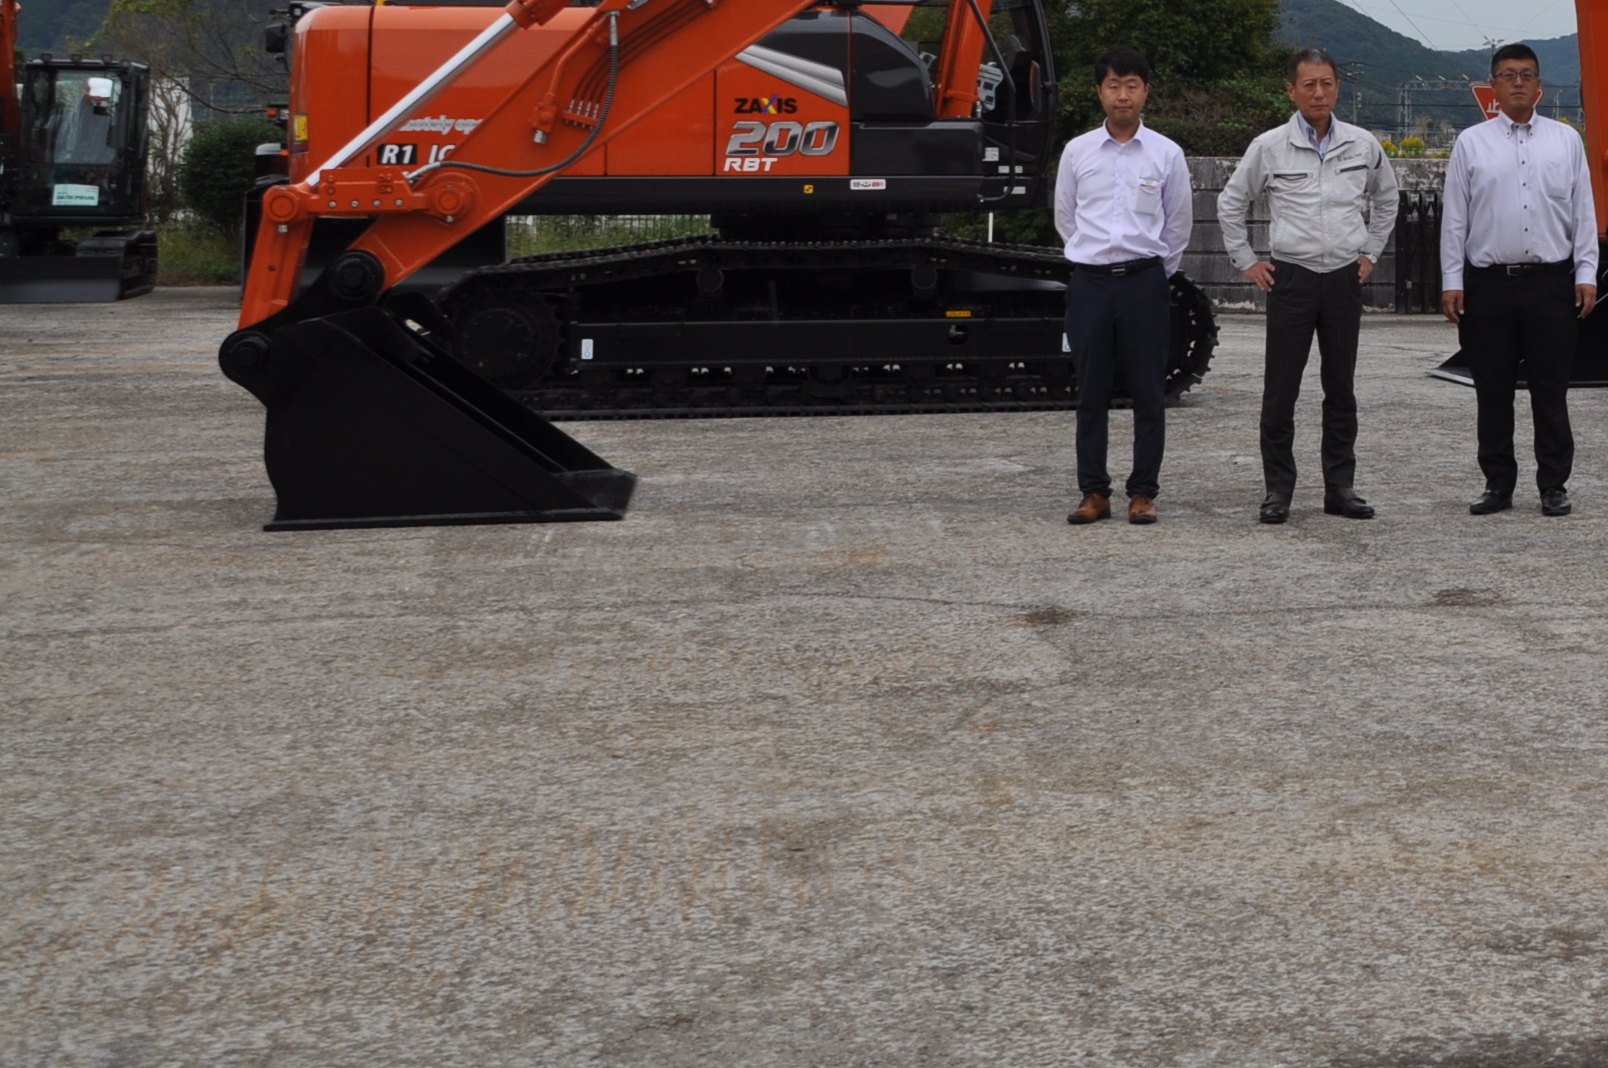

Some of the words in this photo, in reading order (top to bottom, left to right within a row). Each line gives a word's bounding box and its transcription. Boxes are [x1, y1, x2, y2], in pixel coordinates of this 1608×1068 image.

[734, 94, 798, 114] ZAXIS
[725, 121, 841, 157] 200
[381, 143, 414, 165] R1
[723, 157, 778, 172] RBT
